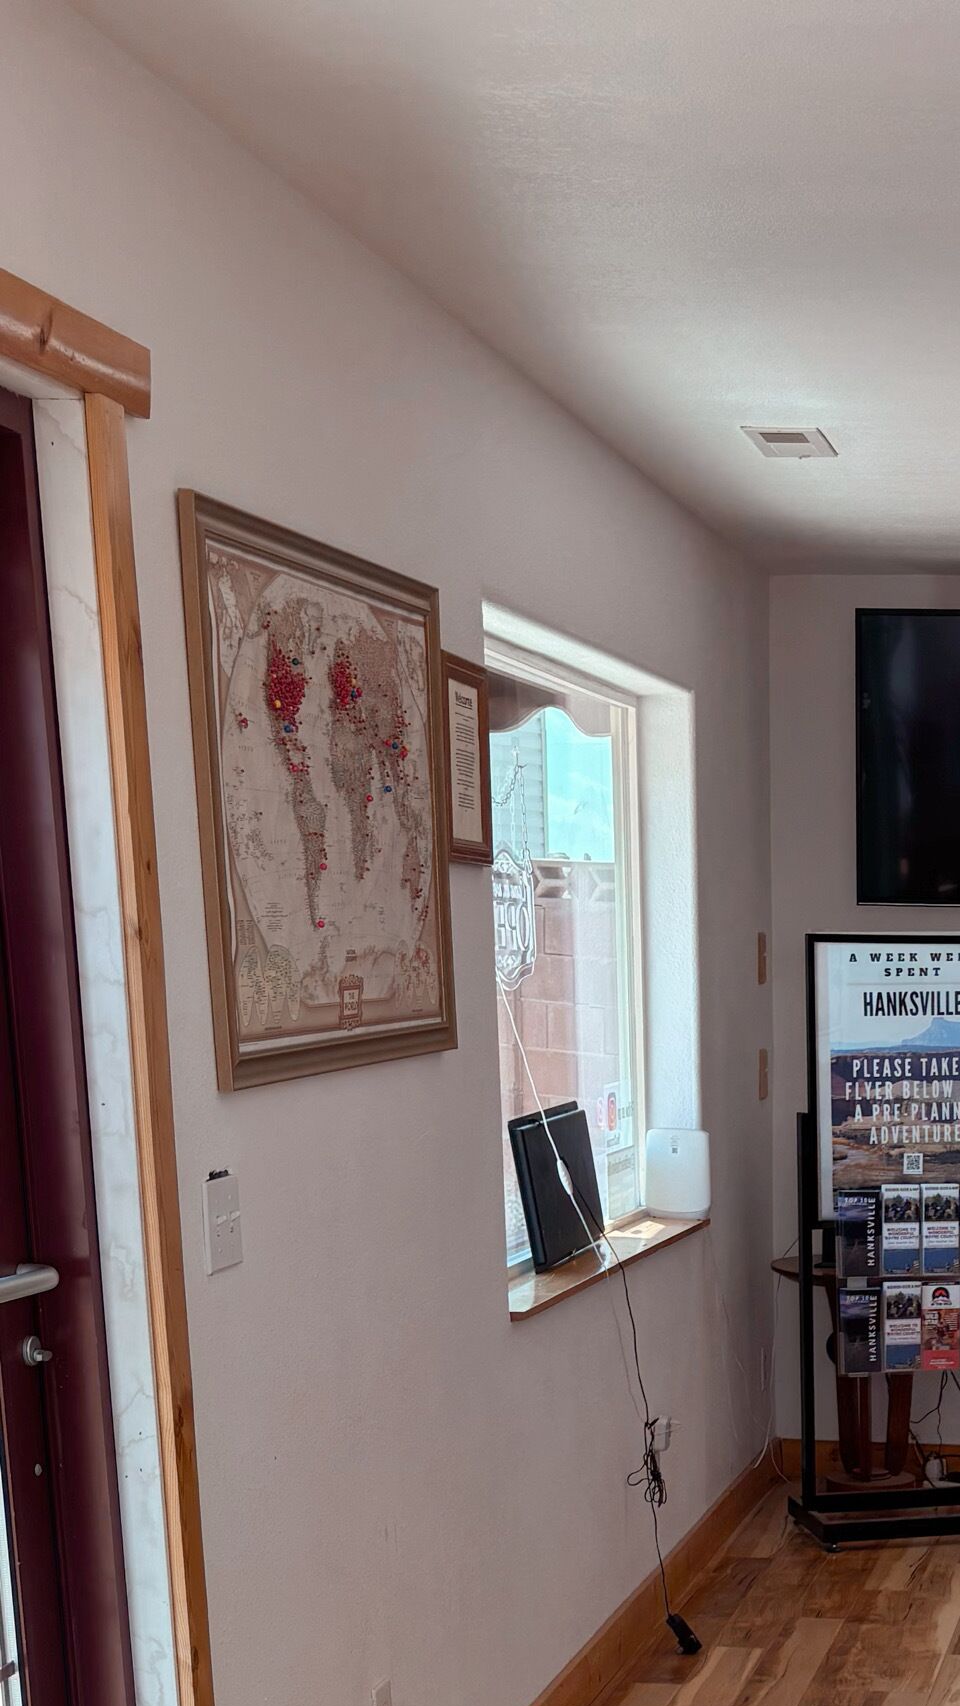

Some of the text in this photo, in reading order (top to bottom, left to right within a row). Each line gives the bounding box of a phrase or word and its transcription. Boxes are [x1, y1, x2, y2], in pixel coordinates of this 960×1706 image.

[849, 953, 858, 962] A
[870, 953, 918, 962] WEEK
[884, 967, 942, 977] SPENT
[852, 1058, 912, 1078] PLEASE
[920, 1057, 959, 1076] TAKE
[845, 1081, 894, 1100] FLYER
[902, 1080, 952, 1098] BELOW
[854, 1104, 864, 1122] A
[866, 1197, 876, 1266] HANKSVILLE
[869, 1295, 878, 1362] HANKSVILLE
